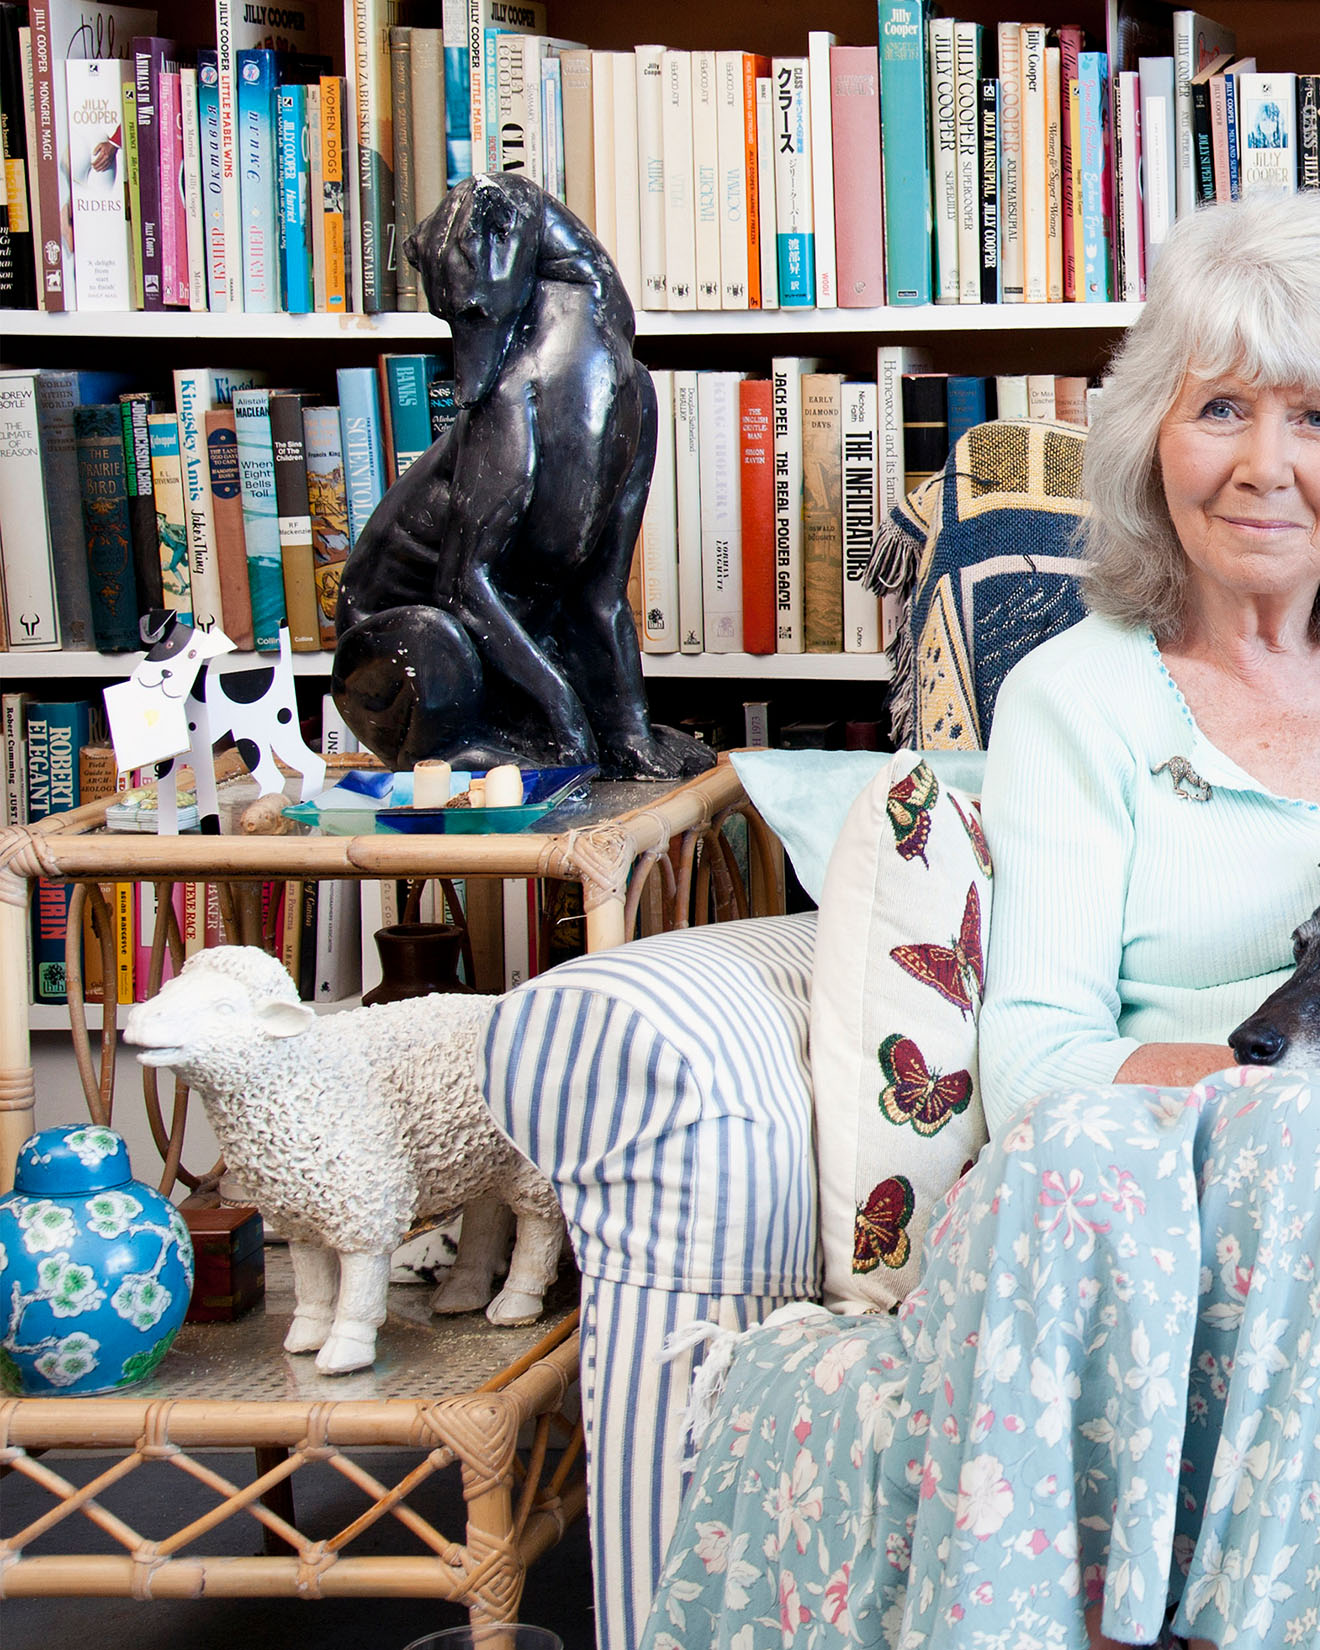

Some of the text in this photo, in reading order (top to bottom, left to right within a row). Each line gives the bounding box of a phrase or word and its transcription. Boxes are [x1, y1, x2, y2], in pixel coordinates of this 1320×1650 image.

[884, 21, 918, 37] Cooper
[890, 8, 912, 24] Jilly
[220, 26, 229, 72] COOPER
[358, 53, 368, 68] TO
[935, 35, 953, 77] JILLY
[1002, 33, 1018, 78] JILLY
[1026, 30, 1040, 92] Jilly Cooper
[33, 8, 52, 161] JILLY COOPER MONGREL MAGIC
[471, 1, 482, 142] JILLY COOPER LITTLE MABEL
[500, 45, 511, 117] COOPER
[511, 45, 524, 99] JILLY
[794, 68, 803, 89] CLASS
[82, 99, 109, 114] JILLY
[222, 76, 230, 109] LITTLE
[326, 84, 337, 131] WOMEN
[778, 68, 794, 153] クラース
[74, 110, 117, 124] COOPER
[223, 111, 232, 145] MABEL
[937, 83, 956, 151] COOPER
[958, 35, 976, 231] JILLY COOPER SUPERCOOPER
[1003, 81, 1019, 152] COOPER
[224, 149, 233, 178] WINS
[327, 140, 338, 174] DOGS
[360, 149, 371, 189] POINT
[648, 156, 664, 193] EMILY
[1252, 153, 1279, 168] JILLY
[77, 199, 122, 212] RIDERS
[984, 109, 997, 268] JOLLY MARSUPIAL JILLY COOPER
[363, 221, 374, 296] CONSTABLE
[396, 367, 417, 406] BANKS
[181, 380, 197, 454] Kingsley
[236, 407, 269, 418] MACLEAN
[811, 421, 832, 429] DAYS
[858, 391, 866, 423] Nicholas
[884, 361, 897, 474] Homewood and its
[89, 450, 110, 459] THE
[132, 401, 152, 495] JOHN DICKSON CARR
[275, 441, 303, 449] The Sins
[276, 454, 304, 462] Children
[845, 431, 873, 462] THE
[187, 456, 201, 501] Amis
[241, 461, 273, 469] When
[244, 470, 271, 479] Eight
[245, 480, 272, 489] Bells
[87, 481, 117, 494] BIRD
[250, 489, 269, 498] Toll
[775, 372, 791, 611] JACK PEEL THE REAL POWER GAME
[7, 707, 18, 818] Robert Cumming JUST
[28, 720, 50, 814] ELEGANT
[49, 726, 73, 808] ROBERT
[207, 884, 219, 929] BAKER
